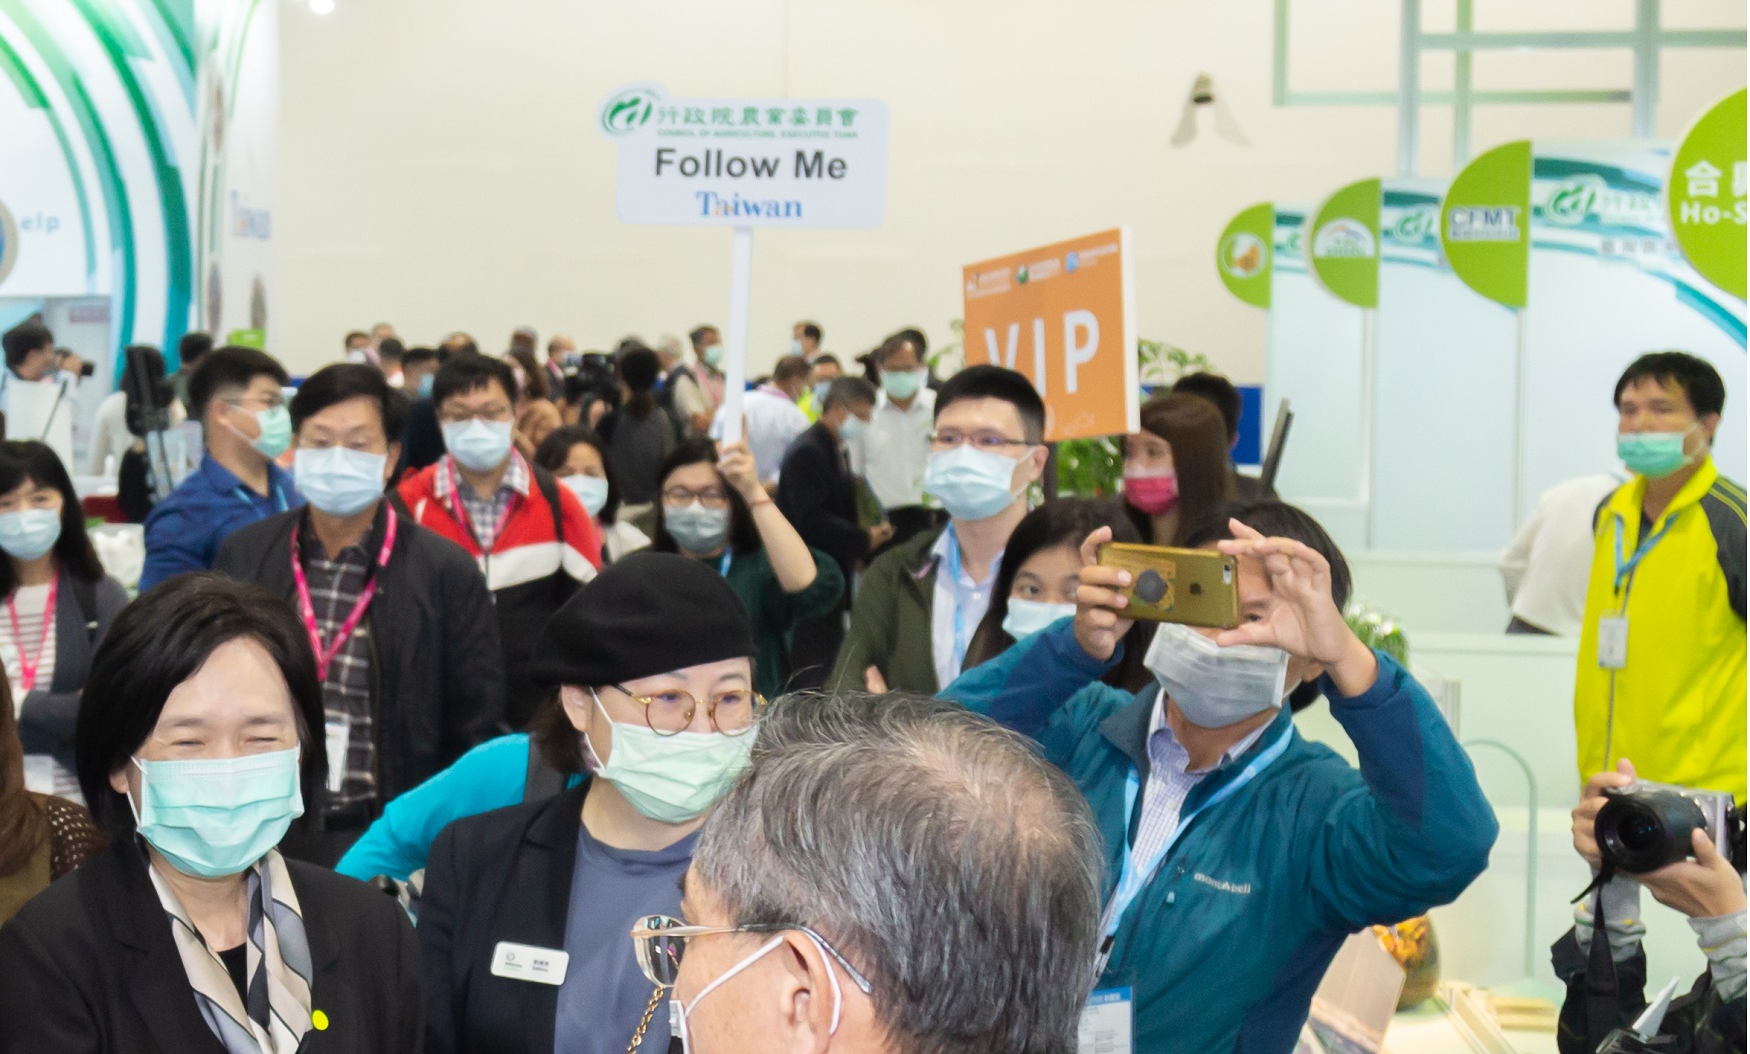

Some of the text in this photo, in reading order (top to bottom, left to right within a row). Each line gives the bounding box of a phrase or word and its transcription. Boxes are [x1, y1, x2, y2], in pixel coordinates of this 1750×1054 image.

[657, 106, 859, 127] 行政院農業委員會
[655, 147, 848, 180] Follow Me
[695, 190, 803, 218] Taiwan
[20, 211, 61, 231] elp
[984, 309, 1100, 398] VIP
